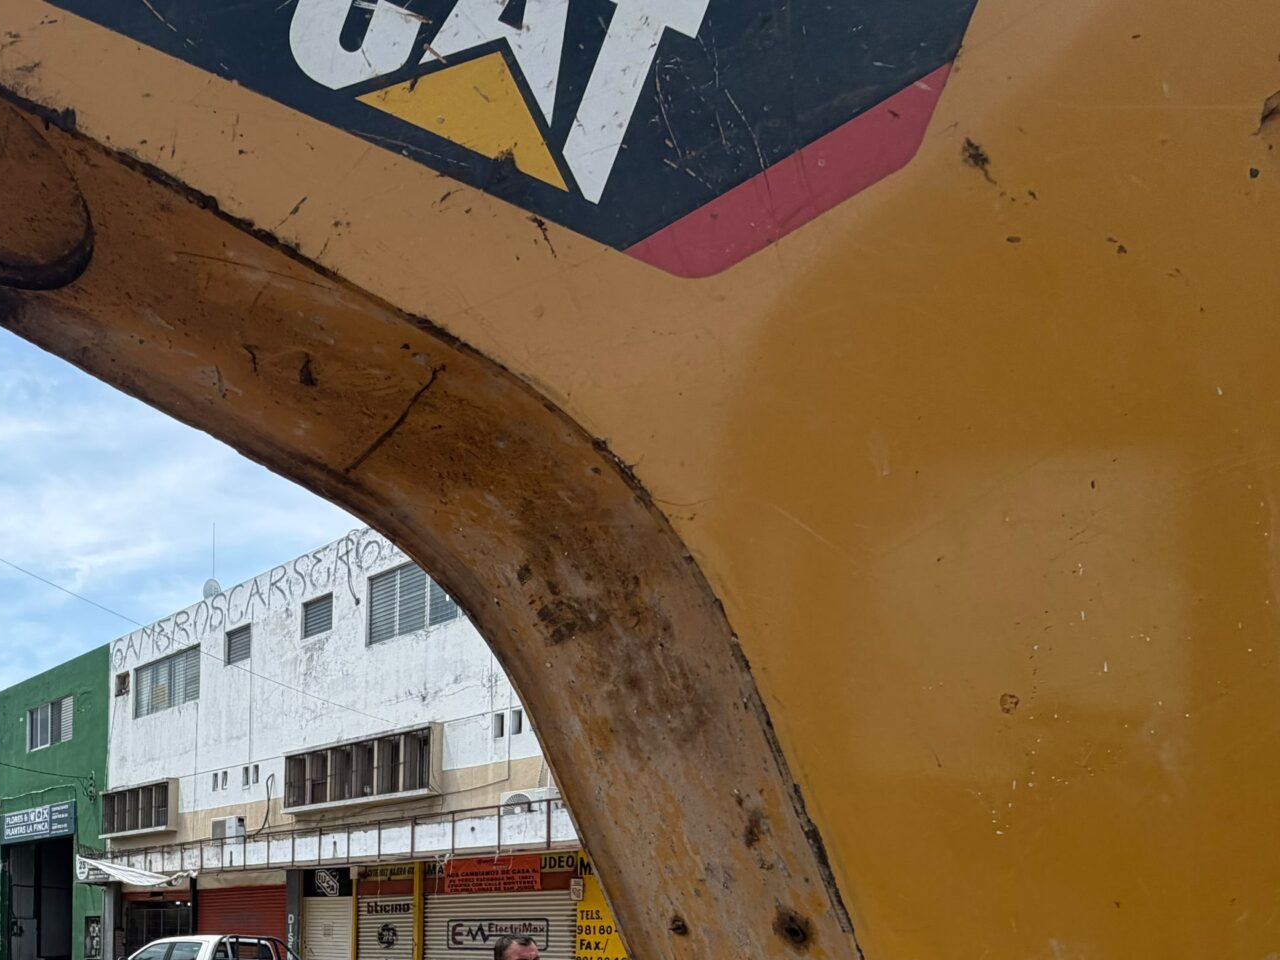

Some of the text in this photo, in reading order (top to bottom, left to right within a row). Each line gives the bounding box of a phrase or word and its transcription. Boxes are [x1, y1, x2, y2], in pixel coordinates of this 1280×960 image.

[6, 824, 26, 836] PLANTAS
[33, 822, 48, 832] FINCA
[367, 901, 410, 914] bticino
[580, 910, 603, 920] TELS.
[488, 922, 545, 934] ElectriMax
